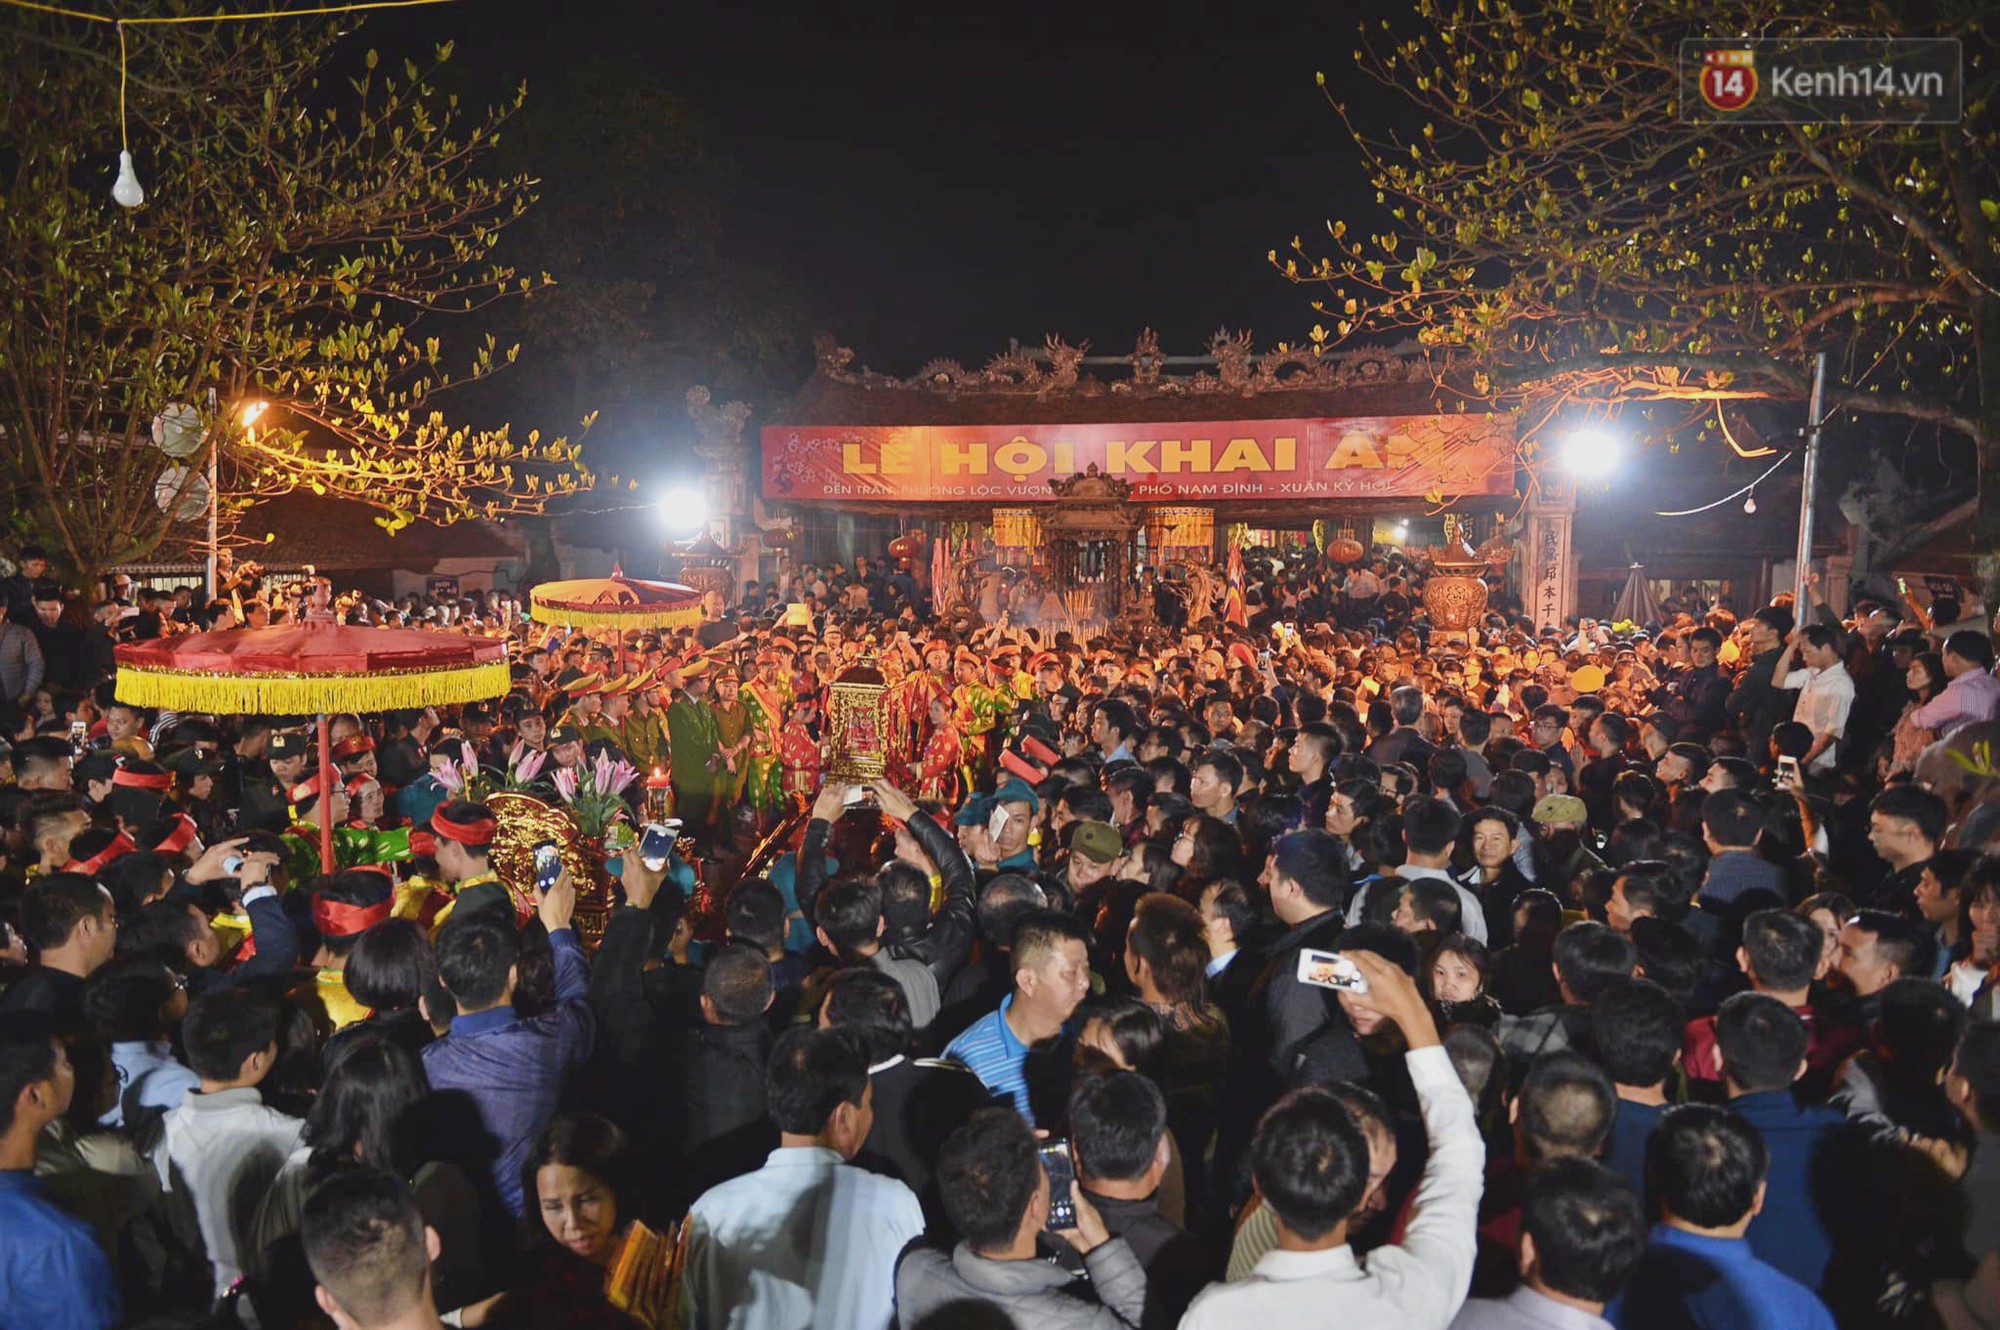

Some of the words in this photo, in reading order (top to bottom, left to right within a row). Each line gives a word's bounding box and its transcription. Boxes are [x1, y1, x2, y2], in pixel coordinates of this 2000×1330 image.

[940, 435, 1076, 482] HỘI
[1106, 437, 1297, 475] KHAI
[970, 484, 1002, 497] LỘC
[1007, 485, 1053, 497] VƯỢN
[1178, 484, 1217, 494] NAM
[1222, 482, 1263, 496] ĐỊNH
[1280, 480, 1328, 493] XUÂN
